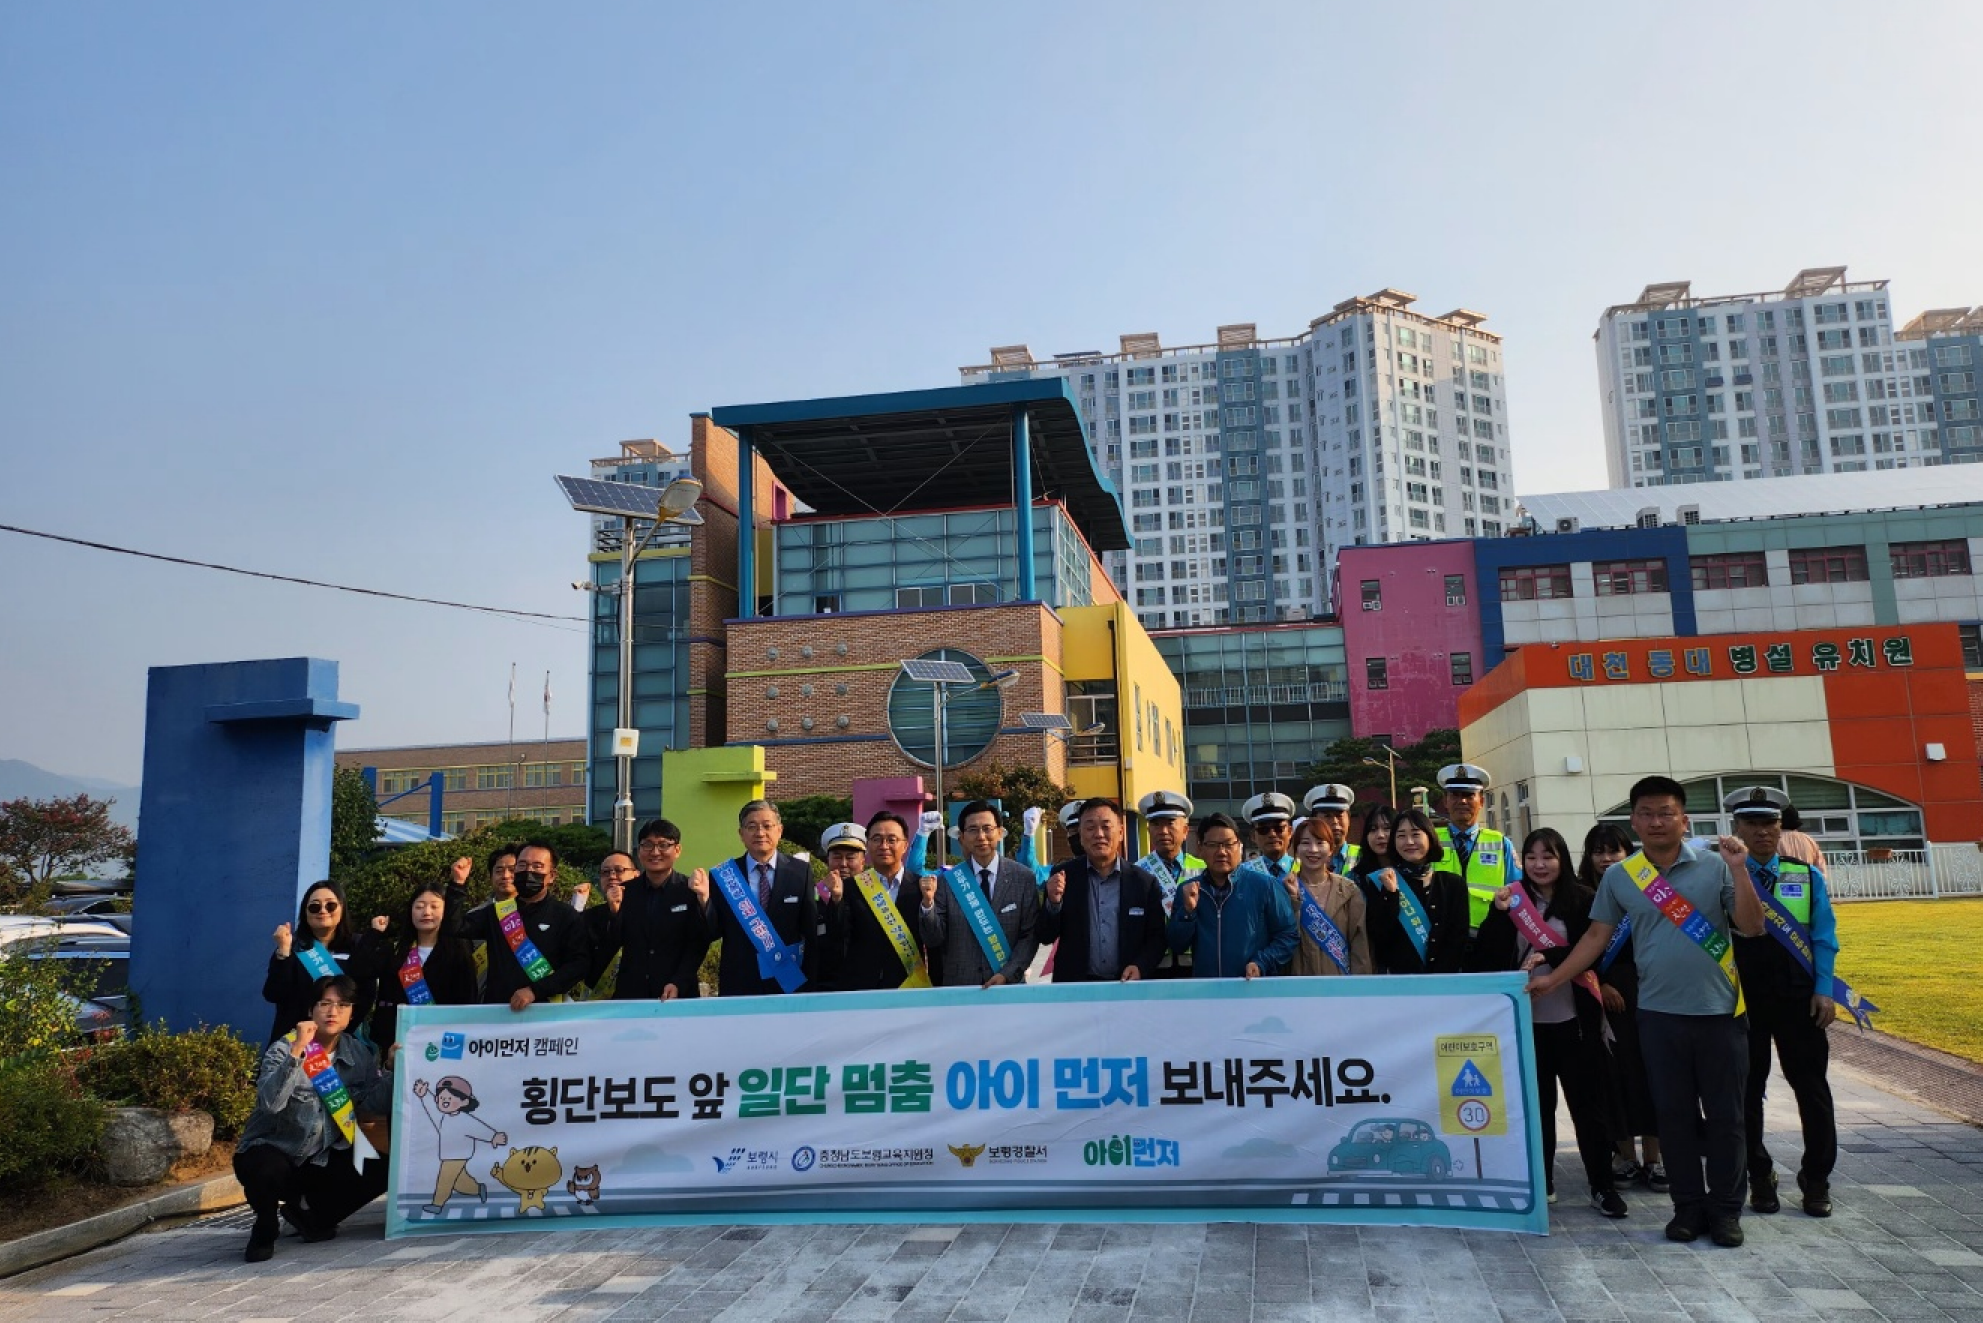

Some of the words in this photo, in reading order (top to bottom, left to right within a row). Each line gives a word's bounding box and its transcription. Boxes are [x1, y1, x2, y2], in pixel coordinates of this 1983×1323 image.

[1568, 652, 1631, 681] 대천
[1648, 647, 1713, 677] 동대
[1729, 642, 1794, 673] 병설
[1812, 637, 1914, 671] 유치원
[468, 1038, 530, 1058] 아이먼저
[533, 1037, 579, 1057] 캠페인
[1440, 1041, 1494, 1053] 어린이보호구역
[520, 1075, 680, 1126] 횡단보도
[688, 1071, 731, 1121] 앞
[737, 1065, 830, 1118] 일단
[841, 1060, 934, 1114] 멈춤
[944, 1056, 1040, 1112] 아이
[1053, 1055, 1151, 1112] 먼저
[1159, 1056, 1391, 1109] 보내주세요.
[1463, 1107, 1485, 1123] 30
[747, 1150, 779, 1164] 보령시
[819, 1147, 935, 1163] 충청남도보령교육지원청
[988, 1145, 1048, 1159] 보령경찰서
[1083, 1134, 1181, 1168] 아이먼저
